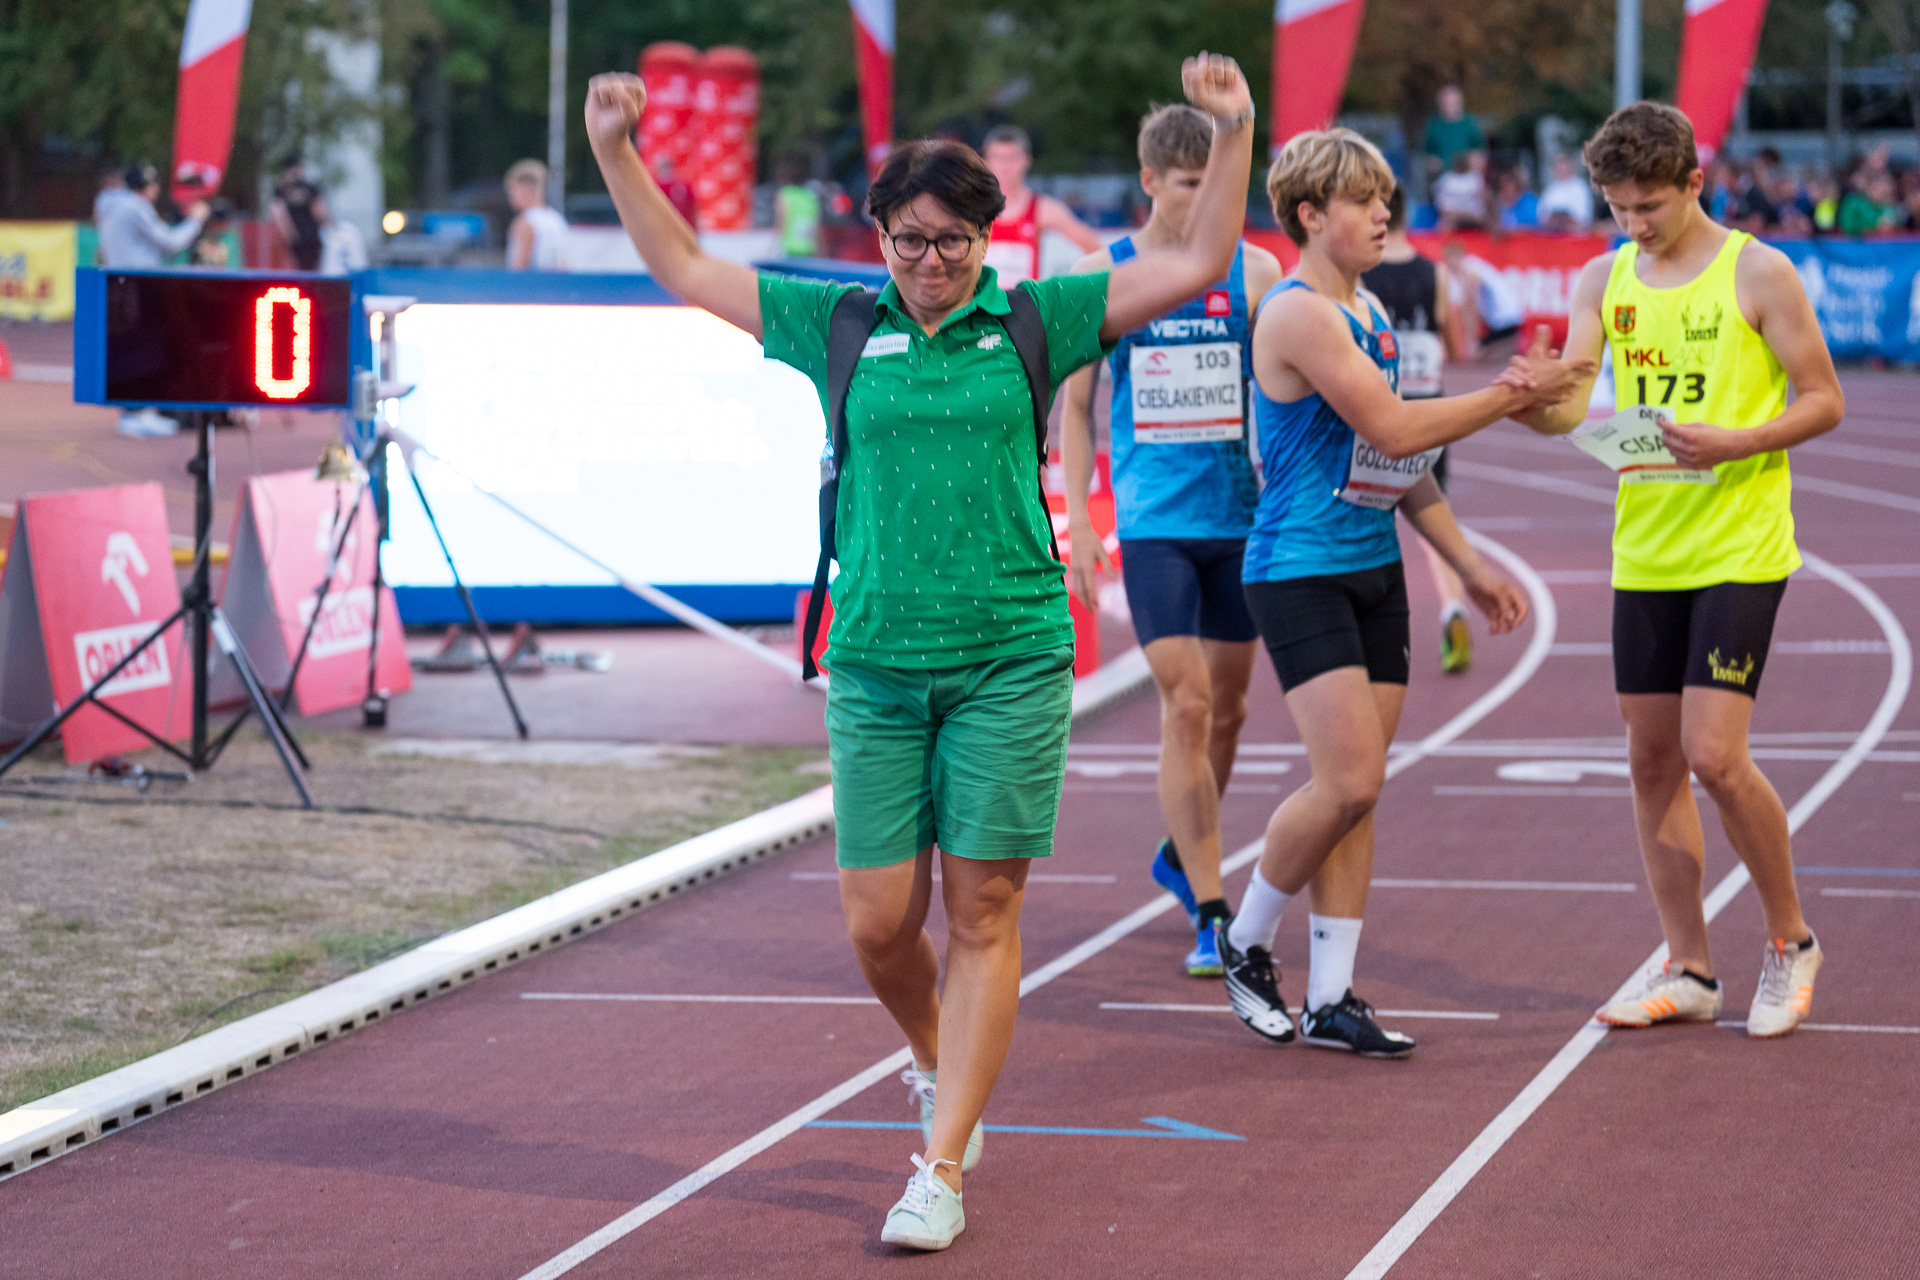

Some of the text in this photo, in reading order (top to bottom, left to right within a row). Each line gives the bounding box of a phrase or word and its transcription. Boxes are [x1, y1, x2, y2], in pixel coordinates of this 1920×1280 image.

[1149, 319, 1229, 338] VECTRA
[255, 286, 311, 399] 0
[1195, 350, 1231, 369] 103
[1624, 348, 1670, 367] MKL
[1137, 384, 1236, 410] CIEŚLAKIEWICZ
[1637, 373, 1706, 406] 173
